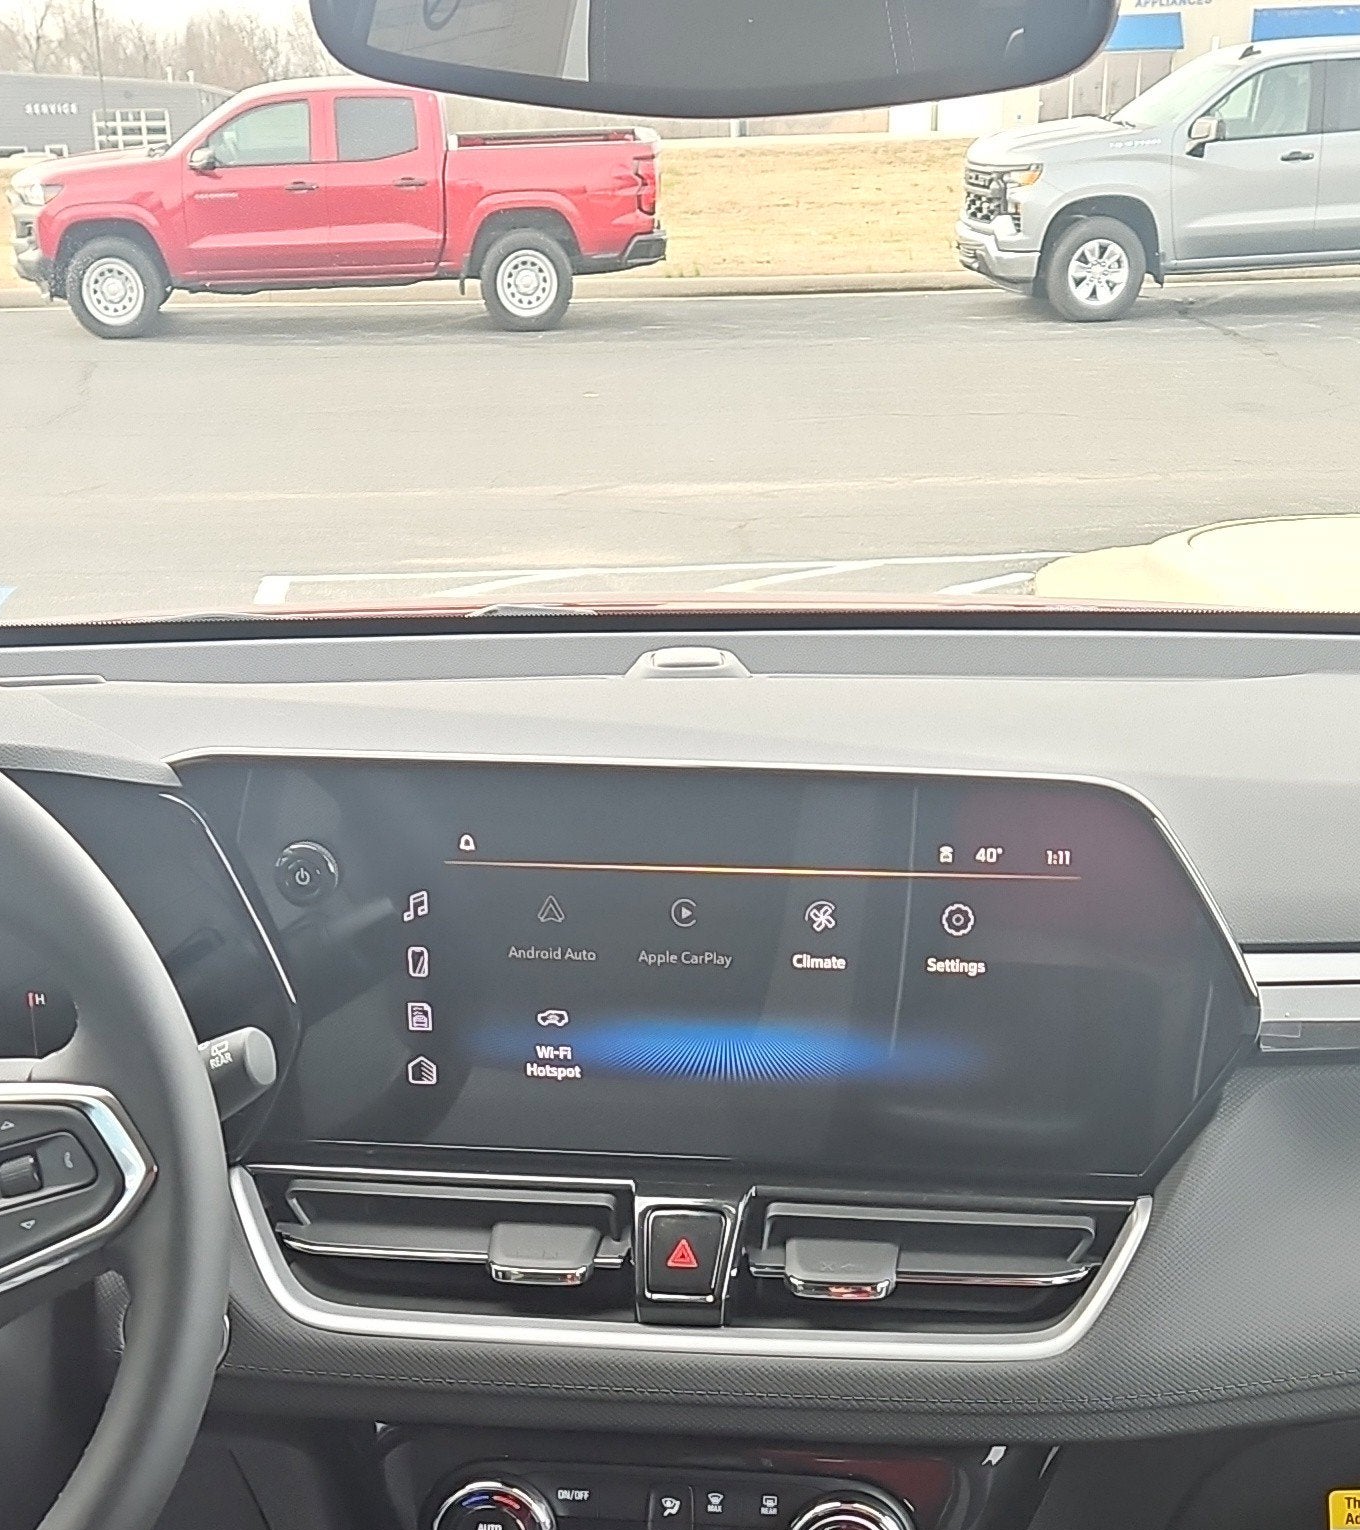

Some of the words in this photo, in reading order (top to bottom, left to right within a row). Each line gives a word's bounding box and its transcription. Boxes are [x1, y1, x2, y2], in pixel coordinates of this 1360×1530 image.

[24, 102, 78, 114] SERVICE
[975, 847, 1003, 863] 40°
[1046, 850, 1071, 866] 1:11
[508, 946, 562, 960] Android
[564, 947, 597, 961] Auto
[638, 950, 678, 967] Apple
[681, 951, 732, 969] CarPlay
[792, 953, 847, 970] Climate
[926, 957, 986, 977] Settings
[34, 993, 46, 1005] H
[535, 1045, 572, 1060] Wi-Fi
[209, 1052, 233, 1070] REAR
[526, 1062, 582, 1081] Hotspot
[557, 1489, 590, 1501] ON/OFF
